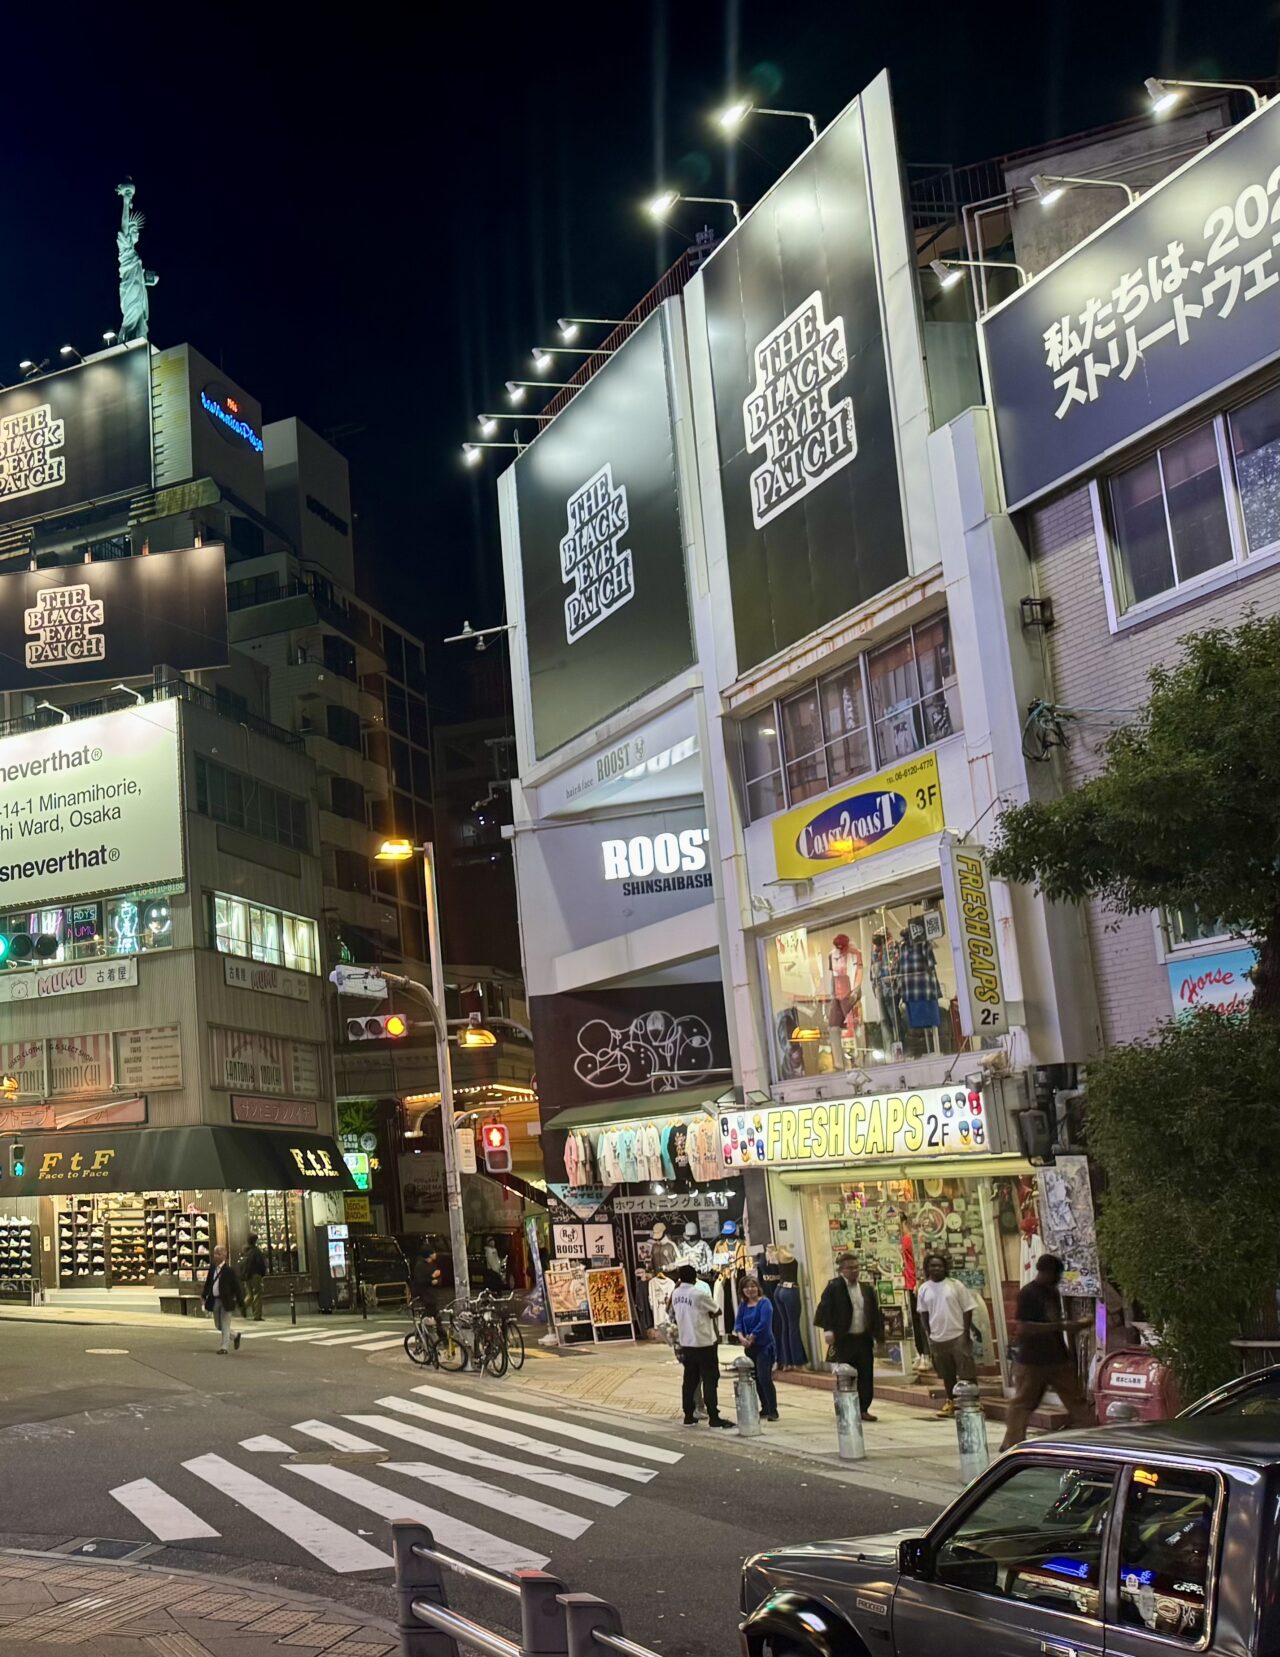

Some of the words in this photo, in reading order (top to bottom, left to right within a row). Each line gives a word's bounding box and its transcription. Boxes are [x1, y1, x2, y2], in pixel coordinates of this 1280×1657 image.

[759, 305, 821, 385] THE
[747, 330, 840, 442] BLACK
[3, 410, 47, 439] THE
[770, 389, 823, 463] EYE
[9, 449, 47, 474] EYE
[756, 409, 852, 519] PATCH
[571, 475, 611, 530] THE
[562, 497, 628, 571] BLACK
[577, 543, 615, 593] EYE
[41, 589, 84, 610] THE
[567, 557, 631, 635] PATCH
[29, 604, 100, 628] BLACK
[29, 637, 101, 663] PATCH
[43, 624, 84, 644] EYE
[596, 742, 631, 783] ROOST
[895, 758, 934, 783] 06-6120-4770
[39, 778, 142, 813] Minamihorie,
[916, 784, 938, 811] 3F
[19, 813, 65, 839] Ward,
[70, 804, 122, 828] Osaka
[623, 872, 713, 897] SHINSAIBASH
[956, 854, 992, 939] FRESH
[38, 966, 87, 997] MUMU
[96, 966, 127, 984] 古着屋
[968, 937, 1001, 1005] CAPS
[1180, 968, 1235, 1004] Horse
[980, 1008, 1000, 1026] 2F
[767, 1103, 846, 1162] FRESH
[849, 1095, 925, 1156] CAPS
[927, 1115, 950, 1148] 2F
[38, 1171, 63, 1181] Face
[66, 1170, 79, 1180] to
[82, 1168, 109, 1179] Face
[300, 1168, 317, 1177] Face
[325, 1168, 340, 1178] Face
[556, 1245, 584, 1255] ROOST
[595, 1245, 605, 1254] 3F
